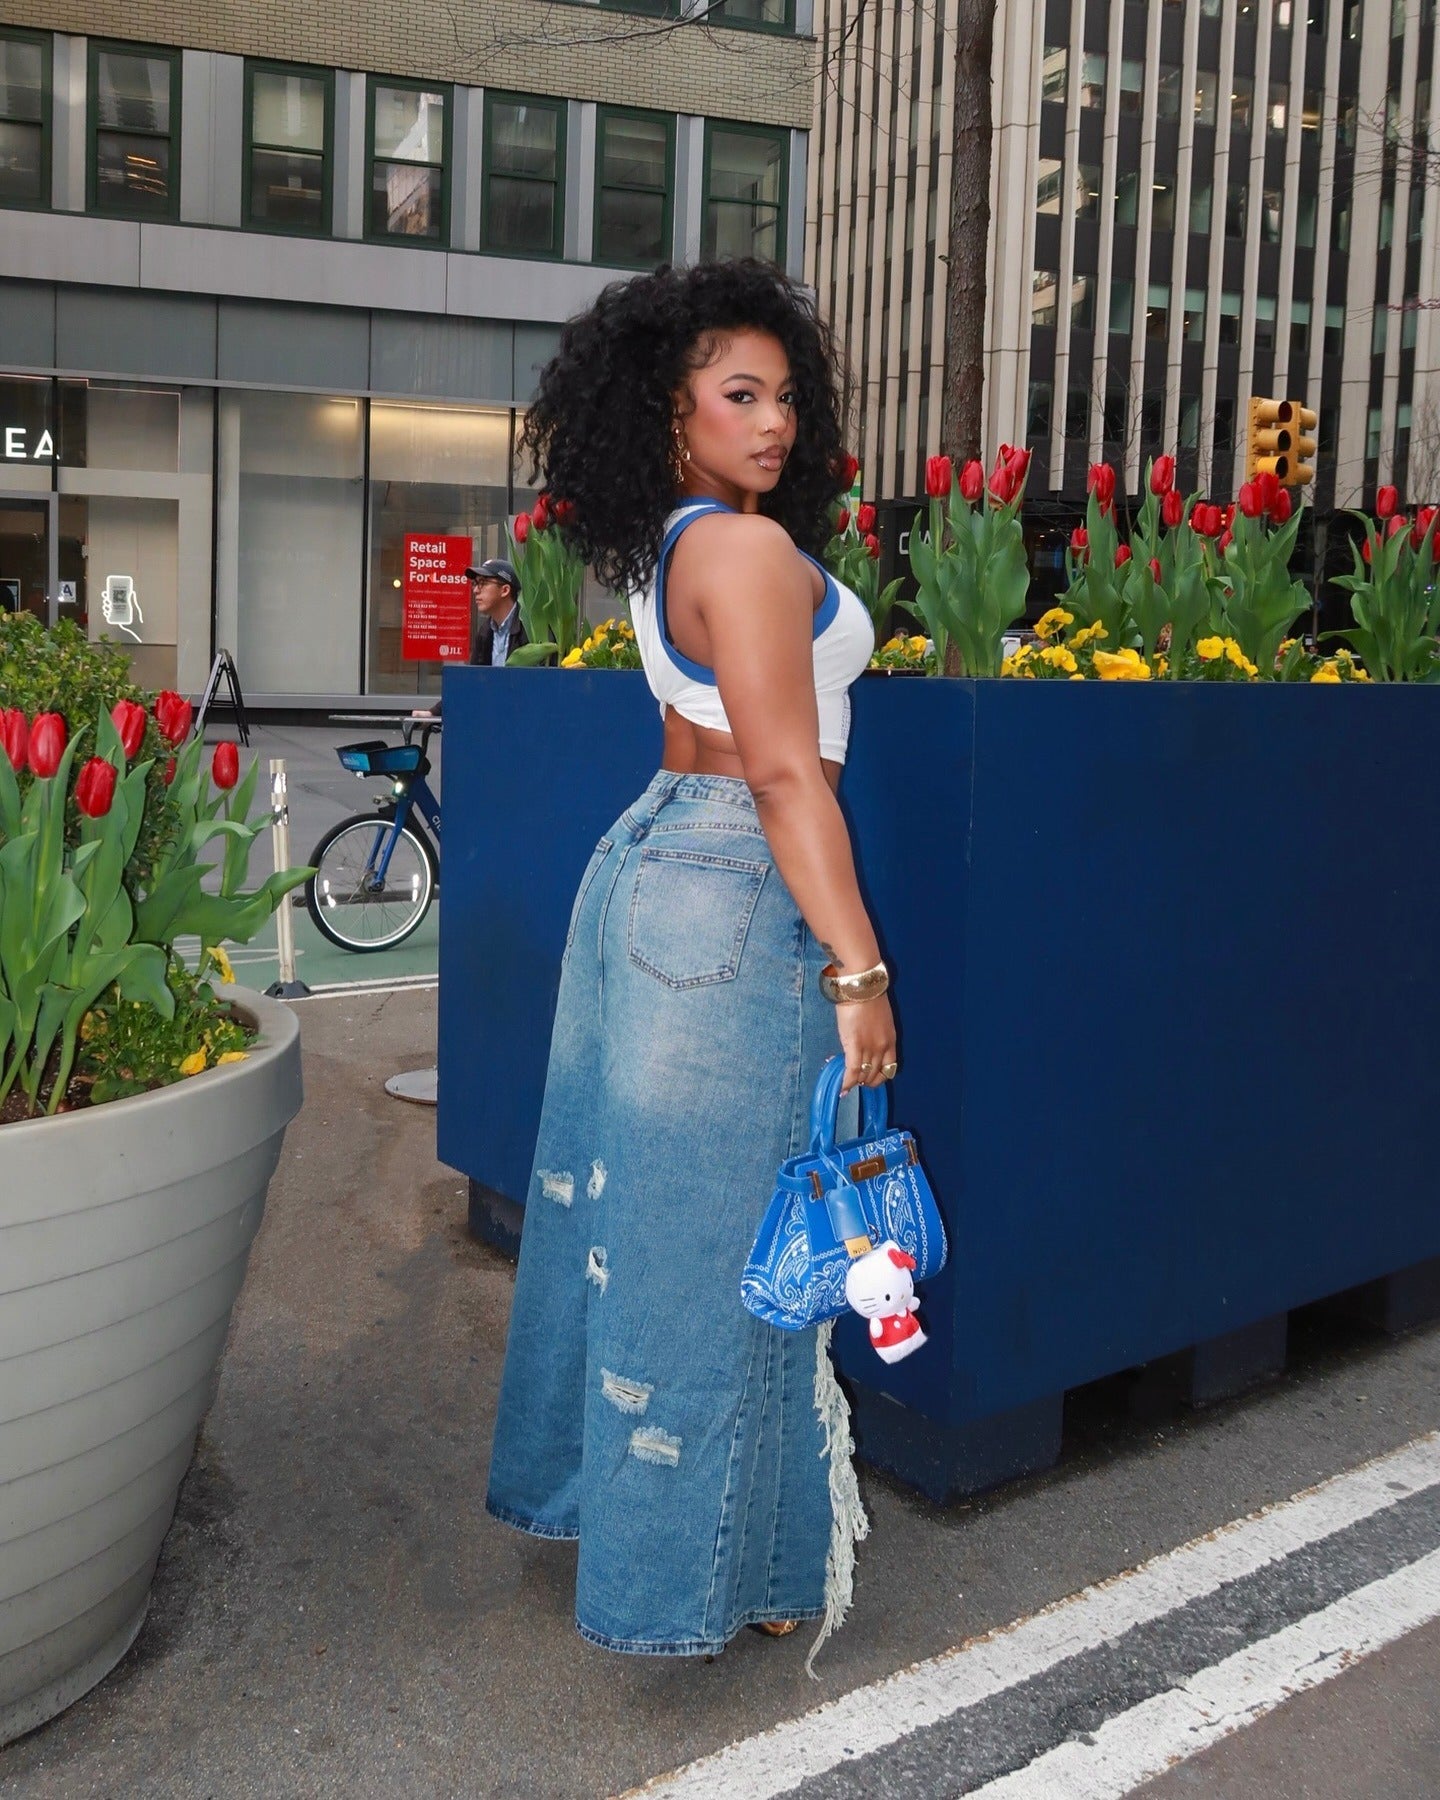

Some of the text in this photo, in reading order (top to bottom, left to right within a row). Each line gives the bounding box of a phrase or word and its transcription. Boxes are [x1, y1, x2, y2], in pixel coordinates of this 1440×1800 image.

[5, 427, 60, 460] EA
[410, 541, 447, 554] Retail
[409, 556, 447, 570] Space
[409, 571, 468, 585] For Lease
[63, 584, 73, 597] A
